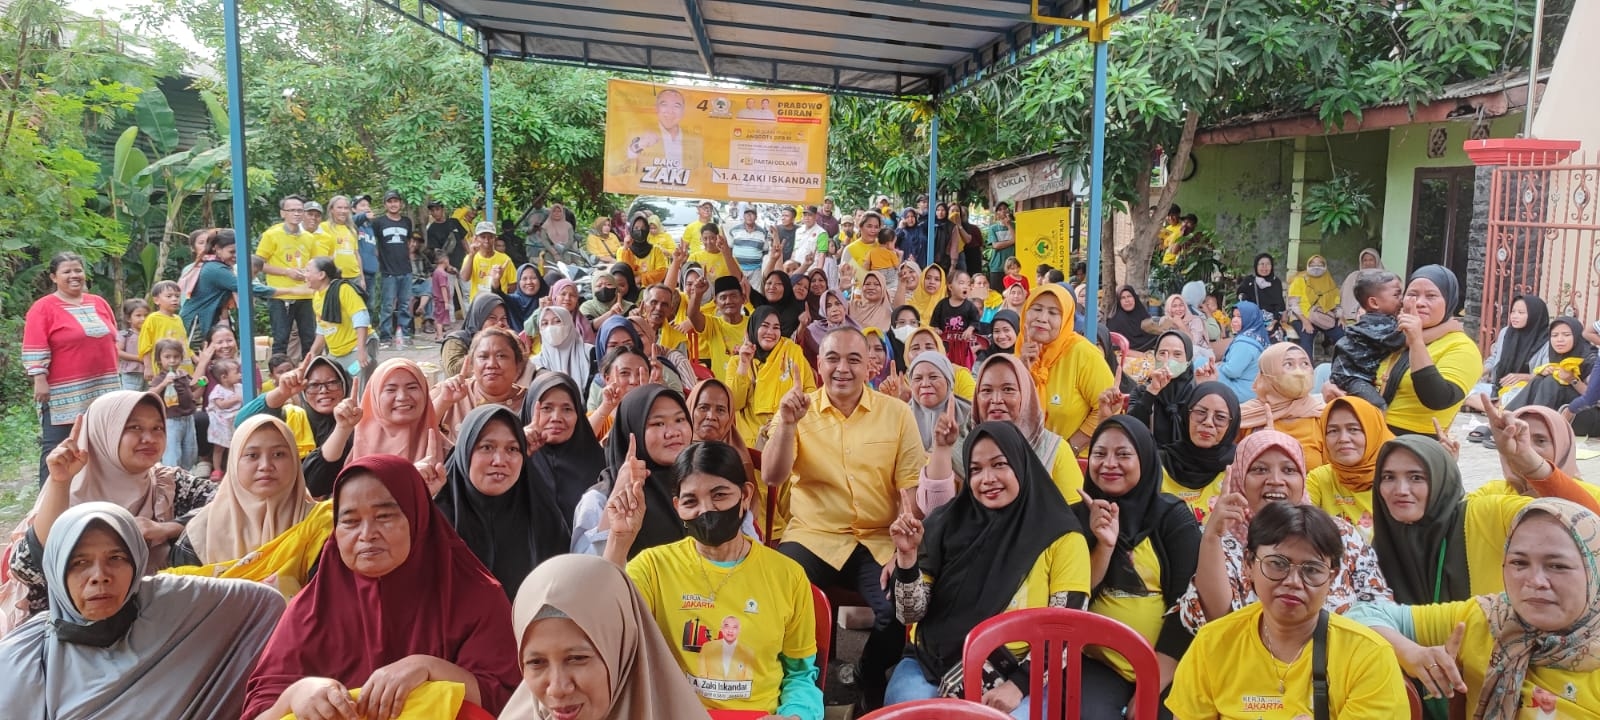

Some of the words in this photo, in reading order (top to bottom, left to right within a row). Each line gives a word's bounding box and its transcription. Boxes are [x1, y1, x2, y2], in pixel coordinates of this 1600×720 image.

[696, 99, 709, 111] 4
[777, 102, 823, 110] PRABOWO
[777, 109, 812, 117] GIBRAN
[653, 158, 680, 167] BANG
[640, 166, 691, 186] ZAKI
[731, 173, 740, 181] A.
[743, 173, 766, 182] ZAKI
[768, 175, 820, 185] ISKANDAR
[997, 175, 1027, 189] COKLAT
[682, 600, 715, 608] JAKARTA
[701, 680, 717, 690] Zaki
[718, 682, 748, 691] Iskandar
